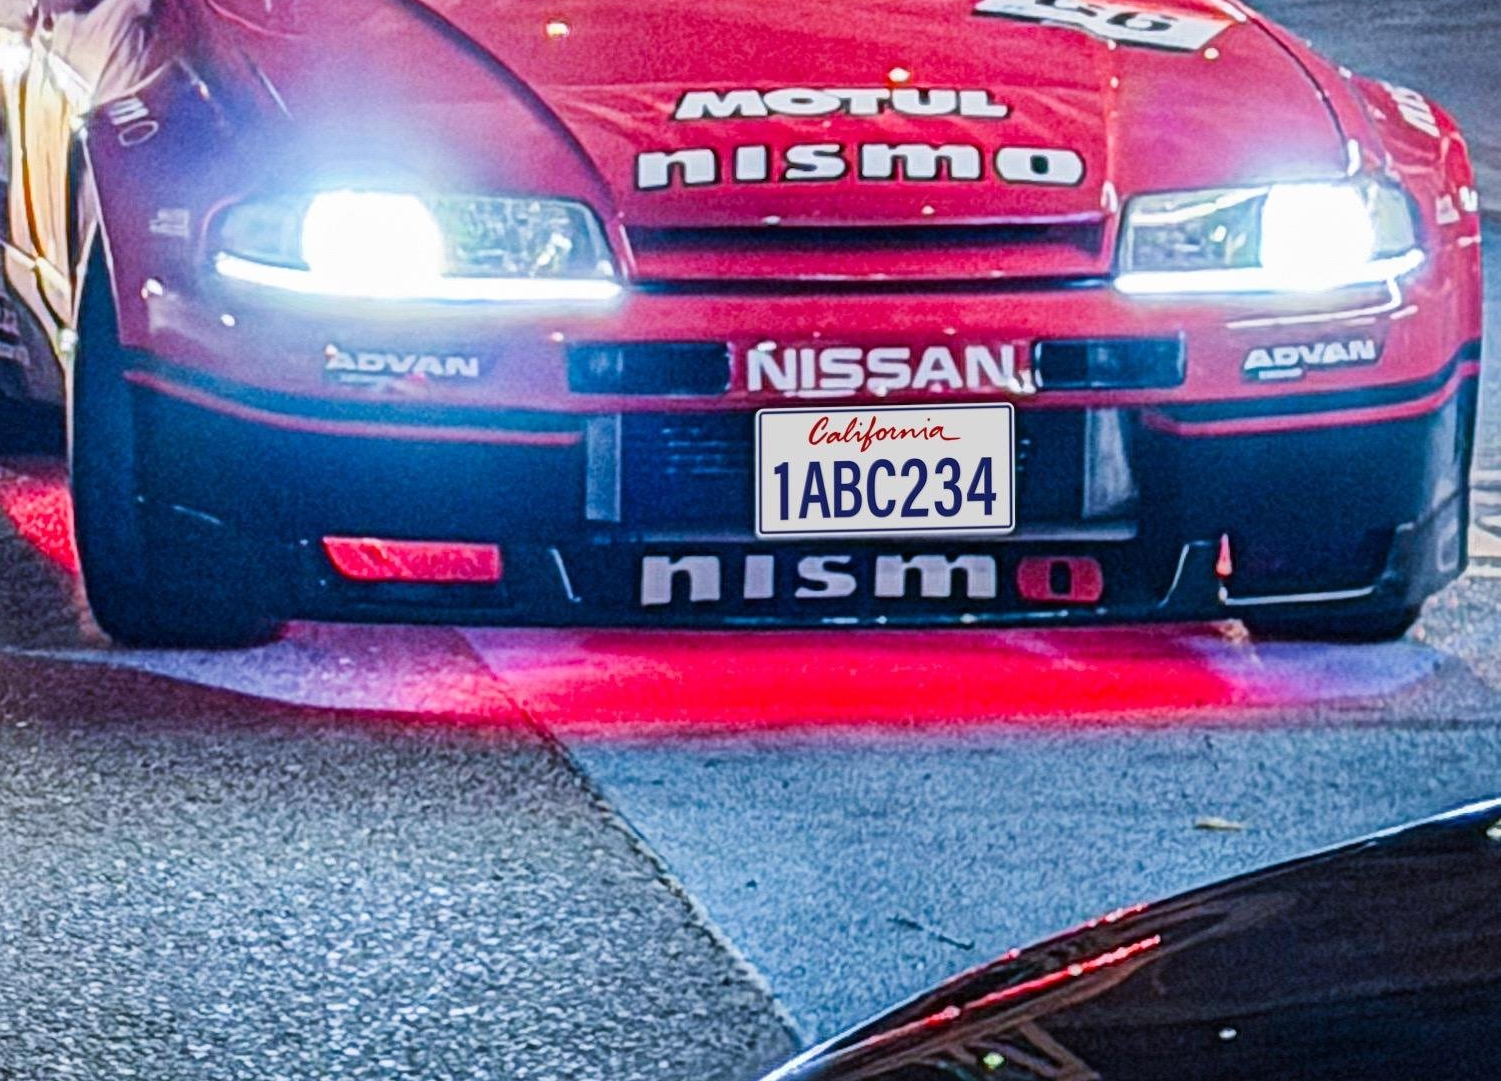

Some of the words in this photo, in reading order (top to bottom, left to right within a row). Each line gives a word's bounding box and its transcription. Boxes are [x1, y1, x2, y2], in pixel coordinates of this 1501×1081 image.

[674, 87, 1009, 120] MOTUL
[635, 142, 1086, 190] nismo
[325, 350, 480, 378] ADVAN
[747, 344, 1016, 393] NISSAN
[1243, 339, 1377, 370] ADVAN
[808, 415, 962, 452] California
[773, 456, 998, 521] 1ABC234
[641, 554, 1105, 607] nismo
